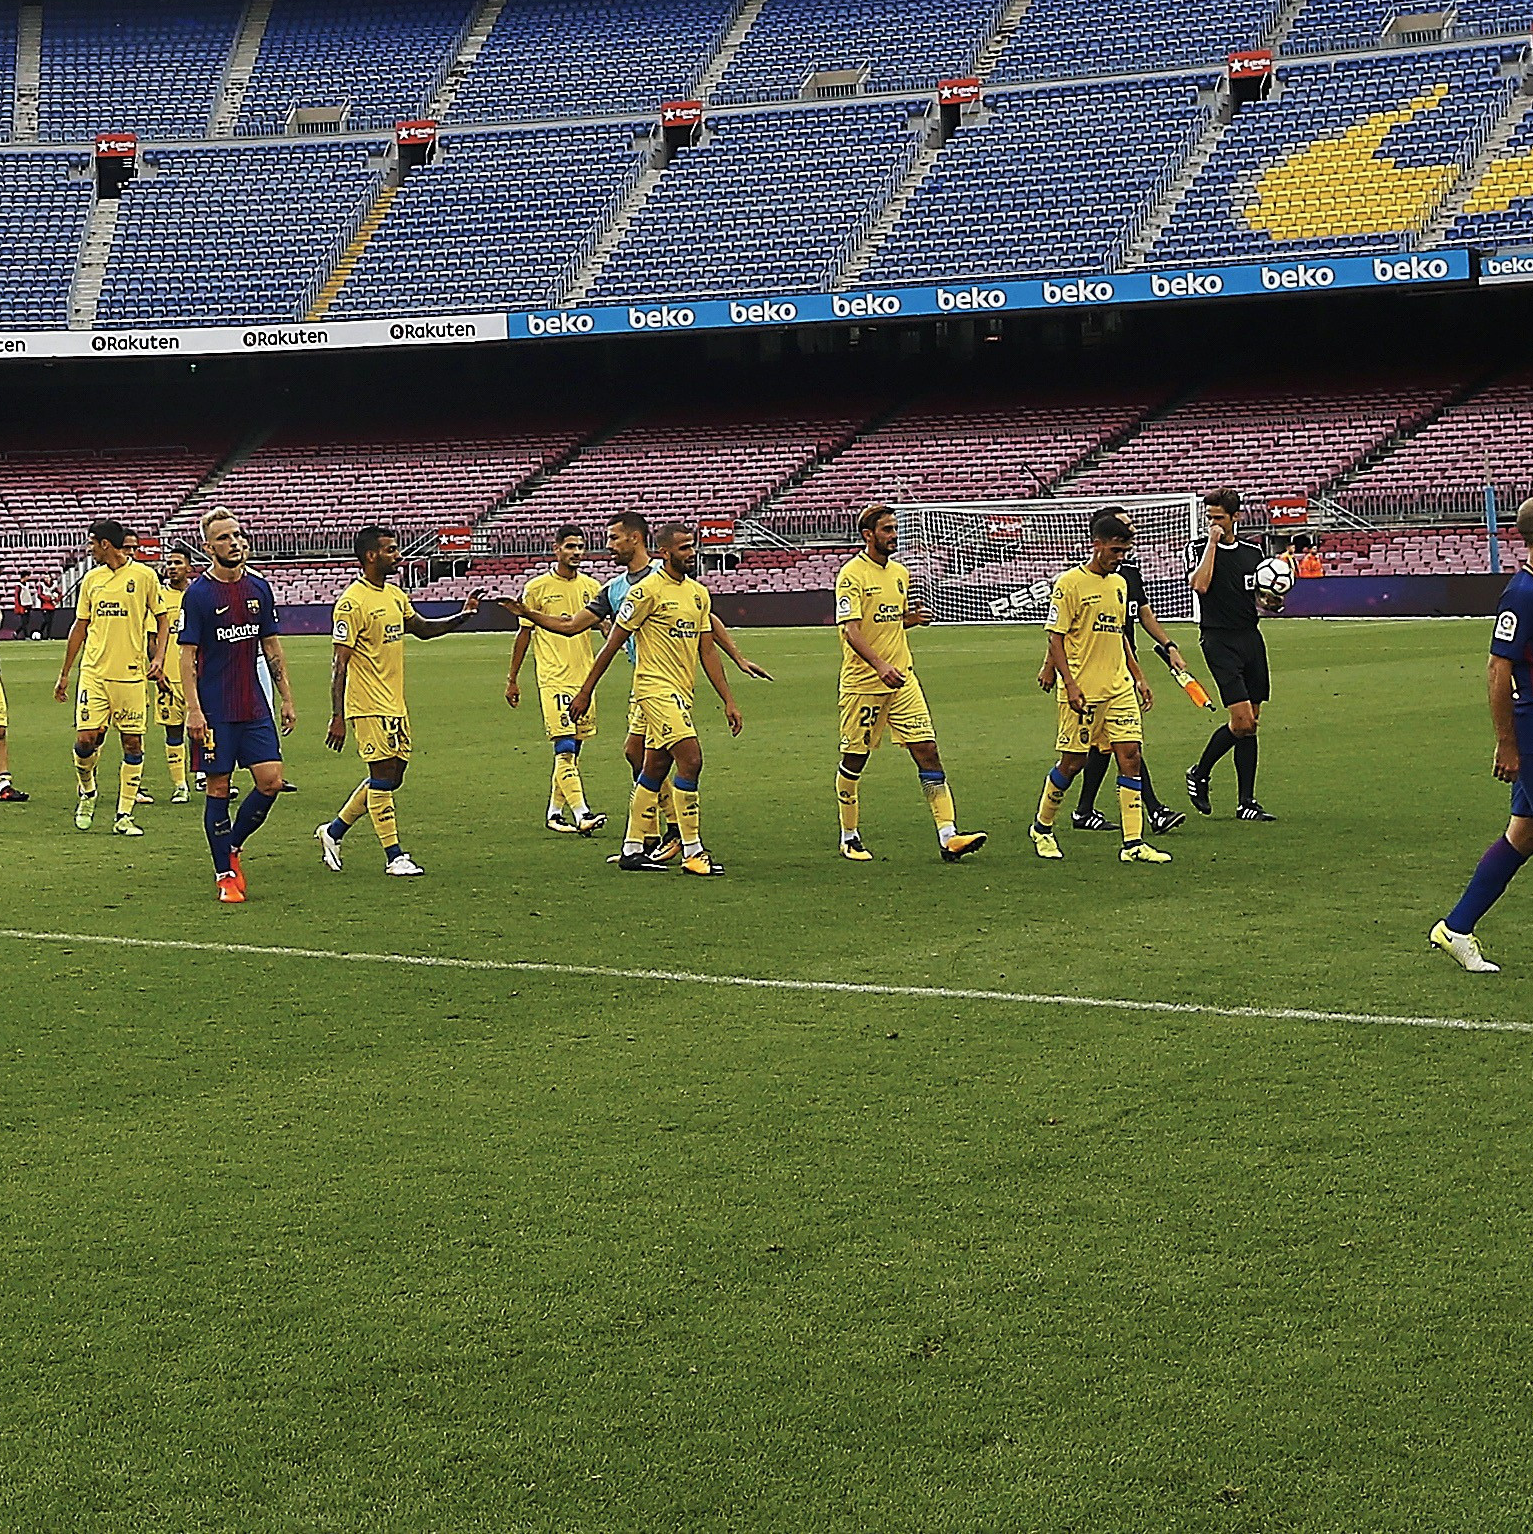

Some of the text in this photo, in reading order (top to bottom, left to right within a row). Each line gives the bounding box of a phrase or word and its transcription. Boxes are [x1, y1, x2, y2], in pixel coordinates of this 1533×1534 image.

[1260, 264, 1335, 292] beko
[1372, 254, 1449, 283] beko
[1042, 278, 1114, 305] beko
[1150, 271, 1224, 298] beko
[729, 299, 797, 324] beko
[832, 292, 901, 318] beko
[936, 287, 1007, 312] beko
[404, 320, 477, 340] Rakuten
[527, 311, 594, 336] beko
[627, 305, 696, 330] beko
[106, 333, 180, 352] Rakuten
[257, 327, 328, 347] Rakuten
[96, 608, 128, 617] Canaria
[98, 600, 120, 609] Gran
[878, 603, 899, 613] Gran
[80, 689, 89, 705] 4
[860, 706, 880, 727] 25
